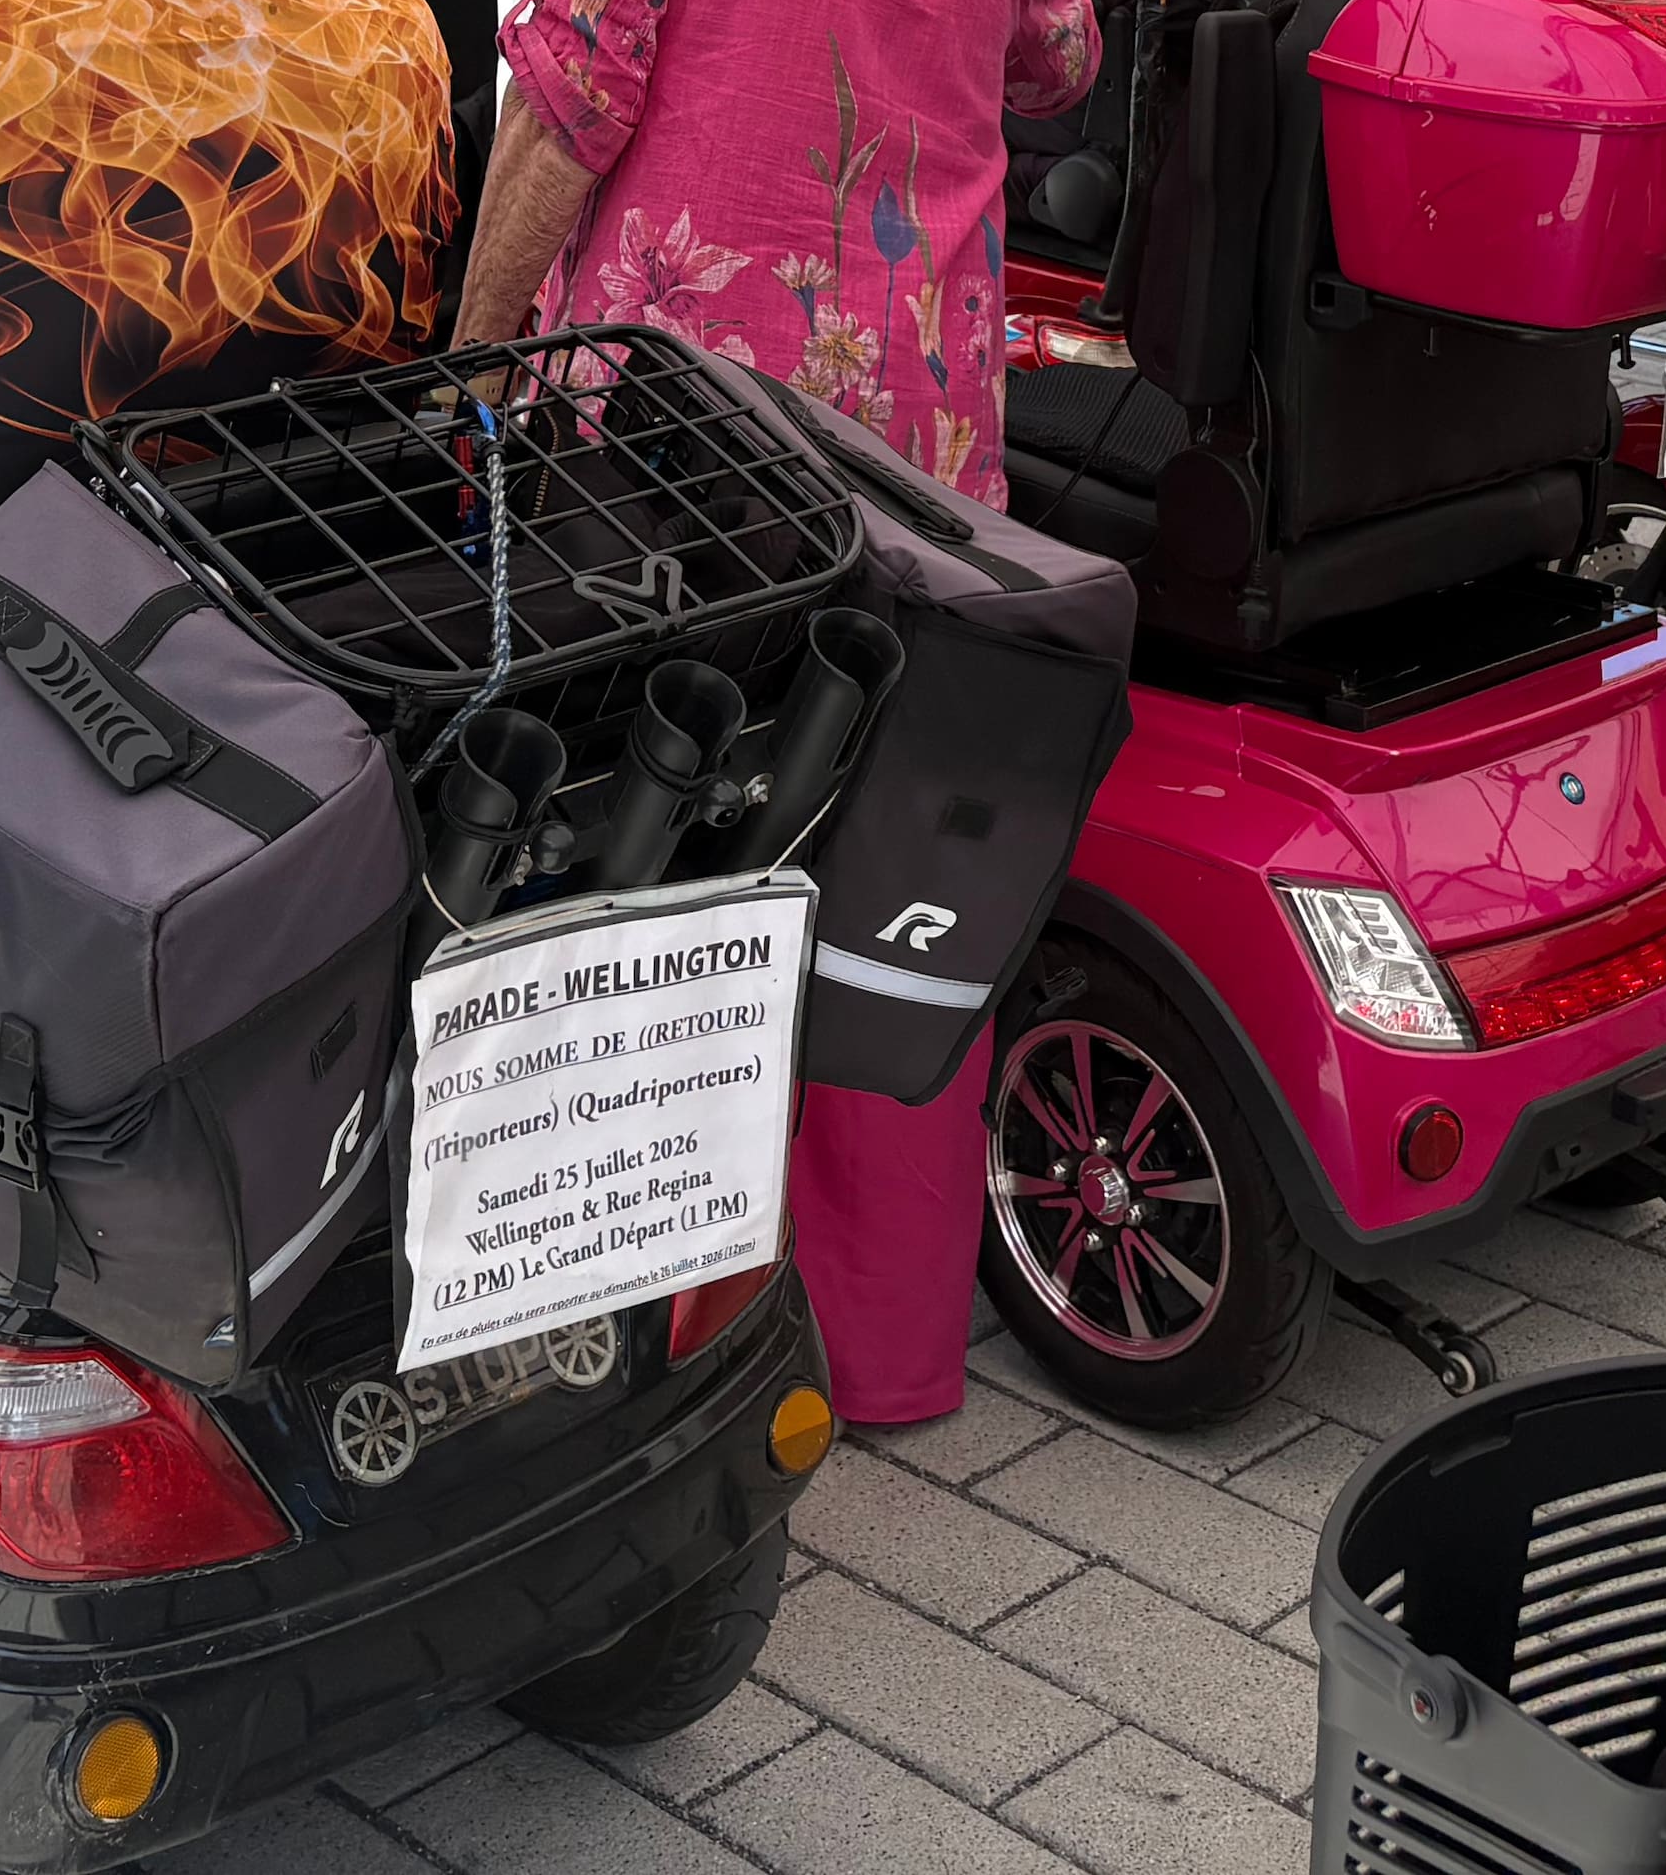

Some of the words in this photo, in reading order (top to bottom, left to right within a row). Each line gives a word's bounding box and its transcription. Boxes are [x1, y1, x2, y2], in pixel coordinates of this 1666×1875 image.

[432, 981, 540, 1044] PARADE
[564, 935, 772, 1001] WELLINGTON
[426, 1066, 483, 1108] NOUS
[494, 1040, 579, 1084] SOMME
[592, 1031, 626, 1059] DE
[639, 1001, 765, 1051] ((RETOUR))
[424, 1098, 559, 1170] (Triporteurs)
[567, 1054, 762, 1126] (Quadriporteurs)
[465, 1210, 576, 1256] Wellington
[582, 1199, 601, 1220] &
[606, 1190, 641, 1215] Rue
[647, 1170, 713, 1203] Regina
[477, 1172, 548, 1214] Samedi
[554, 1163, 579, 1192] 25
[584, 1148, 643, 1188] Juillet
[649, 1129, 699, 1164] 2026
[421, 1336, 435, 1349] En
[436, 1331, 453, 1344] cas
[455, 1327, 468, 1338] de
[503, 1311, 523, 1325] cela
[525, 1305, 546, 1320] sera
[547, 1291, 587, 1313] reporter
[589, 1288, 603, 1301] au
[604, 1274, 649, 1295] dimanche
[650, 1270, 659, 1281] le
[661, 1266, 672, 1278] 26
[672, 1257, 699, 1276] juillet
[701, 1249, 724, 1265] 2026
[433, 1277, 467, 1311] (12
[473, 1264, 515, 1297] PM)
[520, 1256, 546, 1281] Le
[546, 1231, 604, 1270] Grand
[609, 1214, 675, 1252] Départ
[680, 1203, 699, 1232] (1
[706, 1190, 748, 1223] PM)
